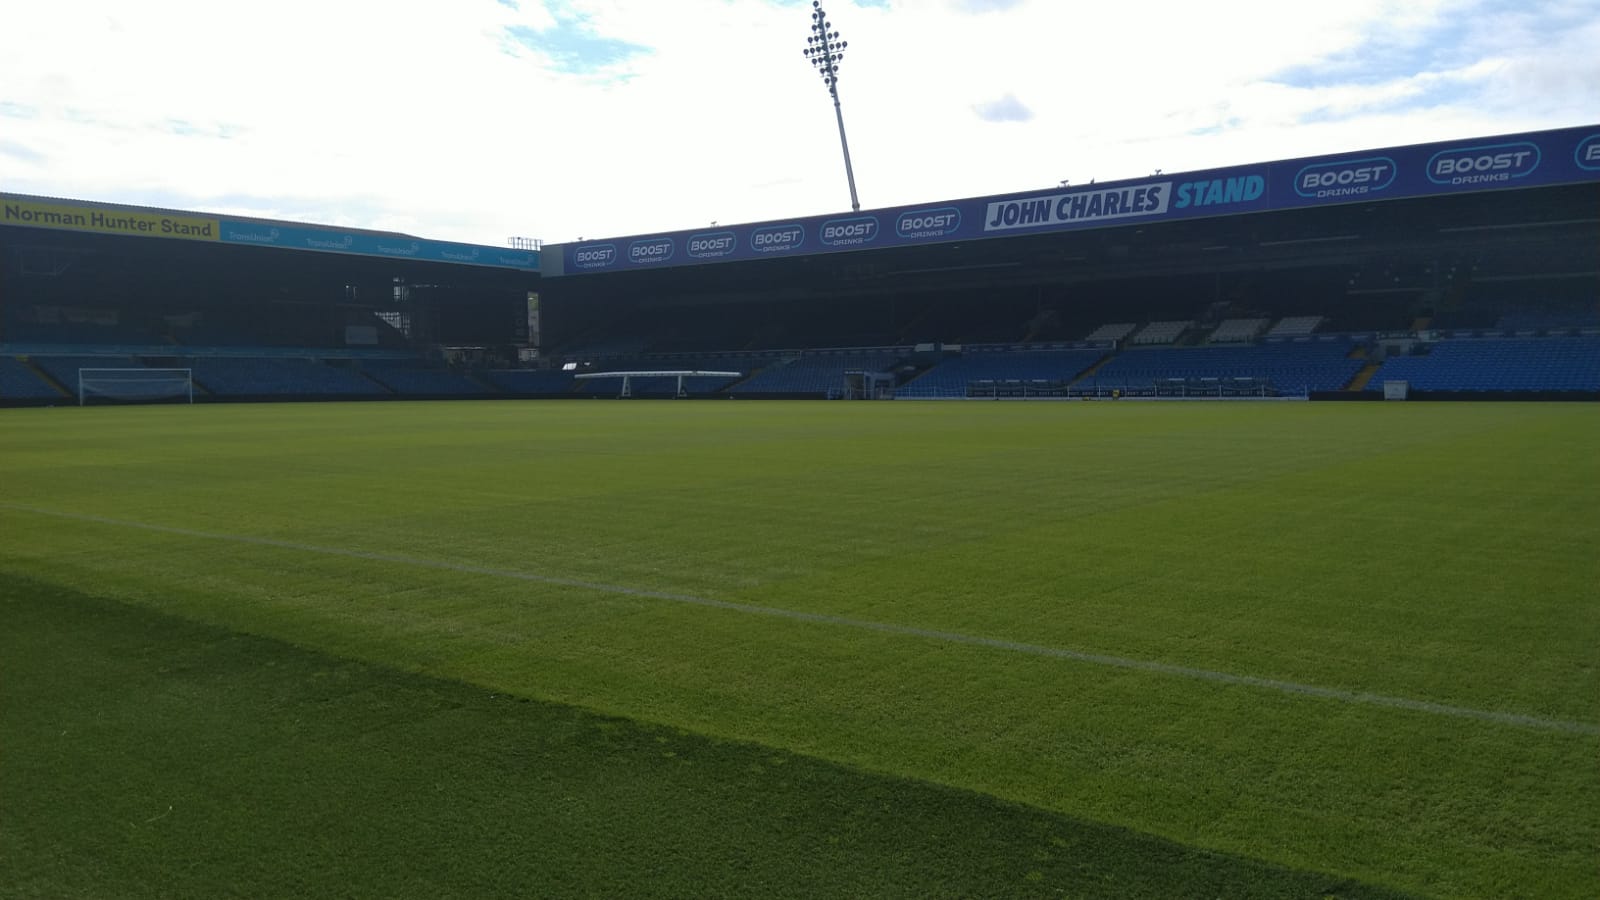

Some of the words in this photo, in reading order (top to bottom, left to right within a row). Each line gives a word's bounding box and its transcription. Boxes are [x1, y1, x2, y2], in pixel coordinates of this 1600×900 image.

[1436, 151, 1531, 175] BOOST
[1303, 166, 1388, 188] BOOST
[1452, 172, 1510, 185] DRINKS
[1317, 186, 1369, 198] DRINKS
[990, 200, 1051, 227] JOHN
[1056, 186, 1162, 221] CHARLES
[1174, 175, 1265, 209] STAND
[5, 205, 86, 227] Norman
[91, 211, 156, 232] Hunter
[161, 218, 212, 237] Stand
[901, 214, 955, 230] BOOST
[755, 230, 800, 245] BOOST
[824, 223, 874, 238] BOOST
[910, 230, 944, 239] DRINKS
[632, 243, 670, 257] BOOST
[691, 237, 732, 251] BOOST
[577, 249, 613, 262] BOOST
